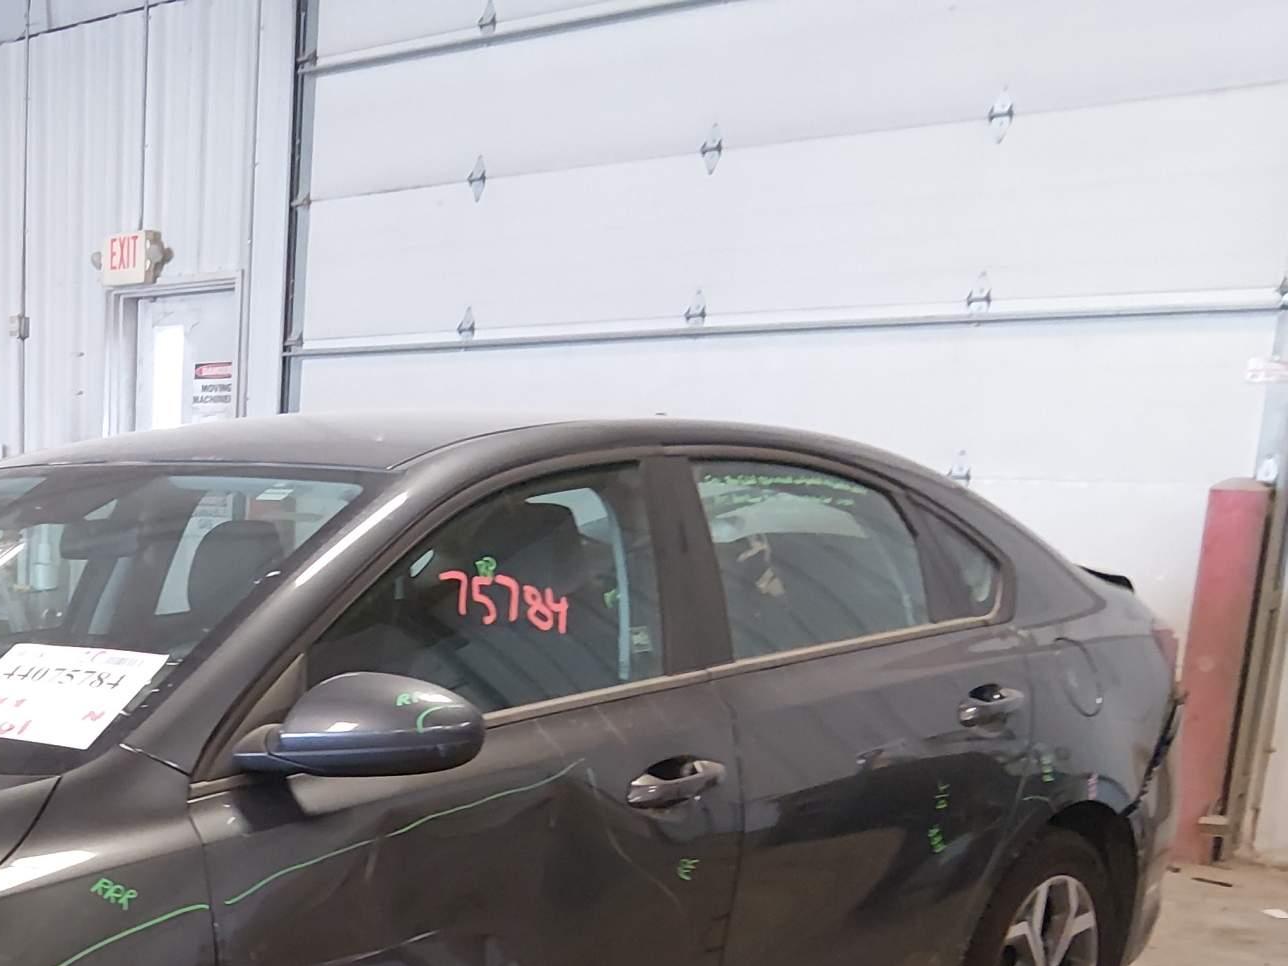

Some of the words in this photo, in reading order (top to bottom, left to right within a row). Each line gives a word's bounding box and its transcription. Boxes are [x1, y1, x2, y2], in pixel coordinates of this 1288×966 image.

[110, 236, 138, 270] EXIT
[439, 570, 569, 634] 75784
[2, 665, 126, 689] 44075784
